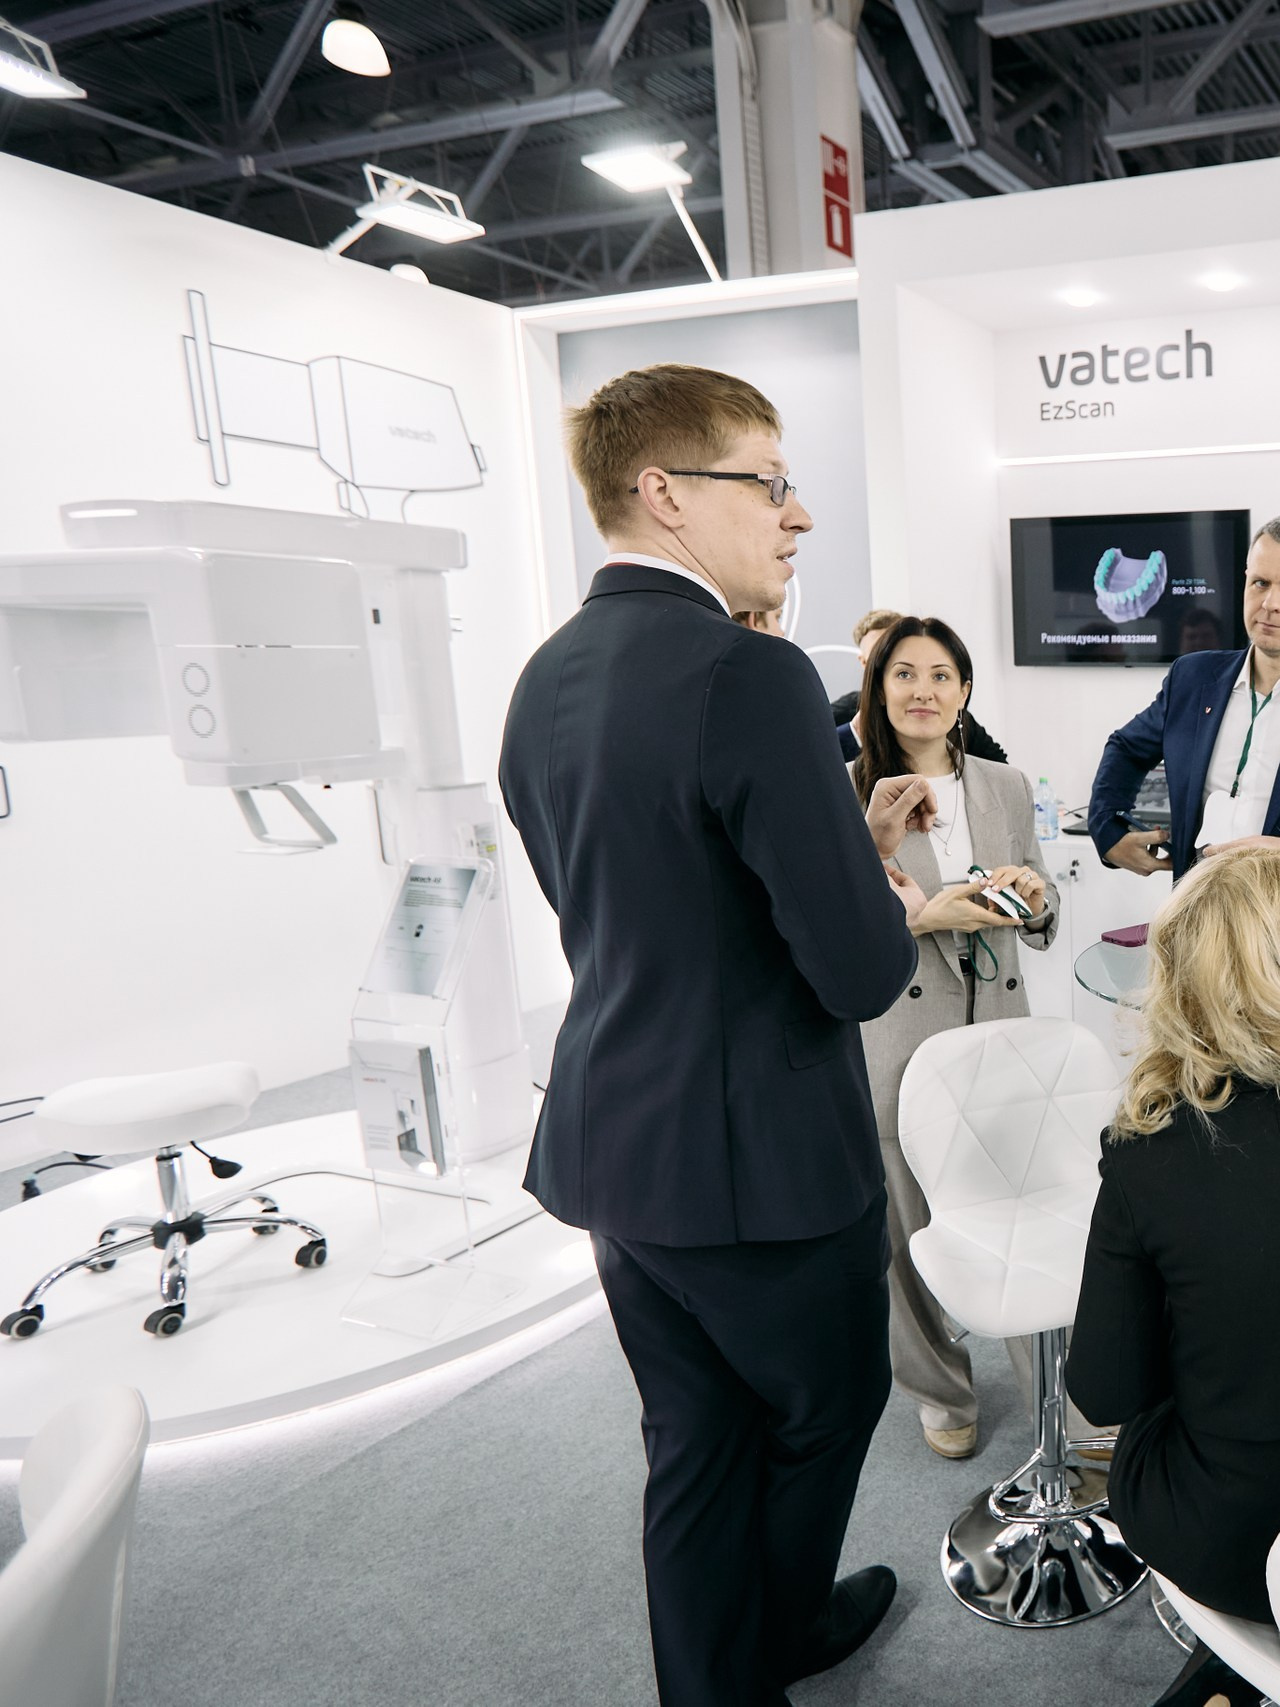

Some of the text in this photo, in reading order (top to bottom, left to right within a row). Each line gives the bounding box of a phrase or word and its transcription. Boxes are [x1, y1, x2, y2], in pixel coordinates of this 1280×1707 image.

[1039, 329, 1214, 389] vatech
[1040, 400, 1115, 421] EzScan
[1041, 632, 1158, 645] Рекомендуемые показания
